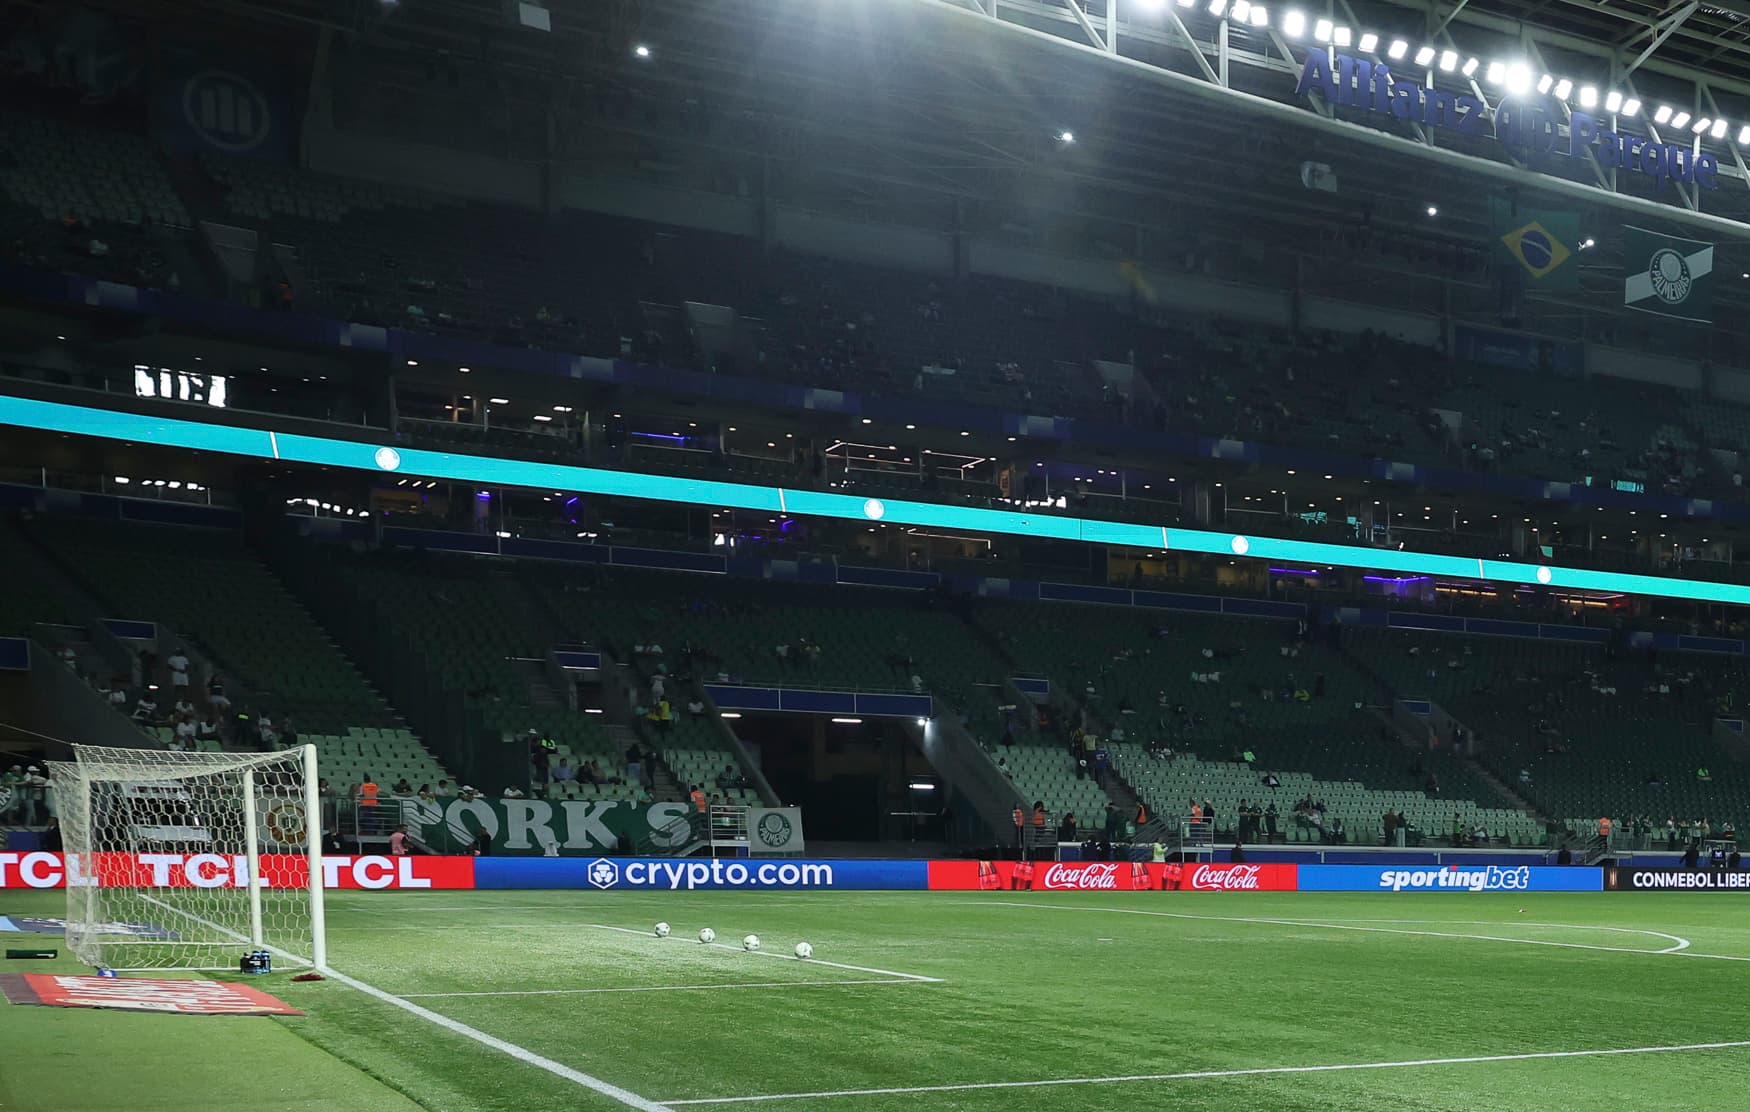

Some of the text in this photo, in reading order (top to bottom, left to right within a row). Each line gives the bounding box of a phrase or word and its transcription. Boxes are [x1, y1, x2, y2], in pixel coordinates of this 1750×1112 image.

[1570, 111, 1719, 193] Parque
[1651, 270, 1690, 300] PALMEIRAS
[402, 798, 692, 849] PORK'S
[139, 853, 269, 888] TCL
[321, 855, 432, 889] TCL
[625, 858, 833, 890] crypto.com
[1044, 863, 1119, 888] Coca-Cola
[1192, 864, 1261, 889] Coca-Cola
[1379, 865, 1529, 891] sportingbet
[1632, 872, 1715, 889] CONMEBOL
